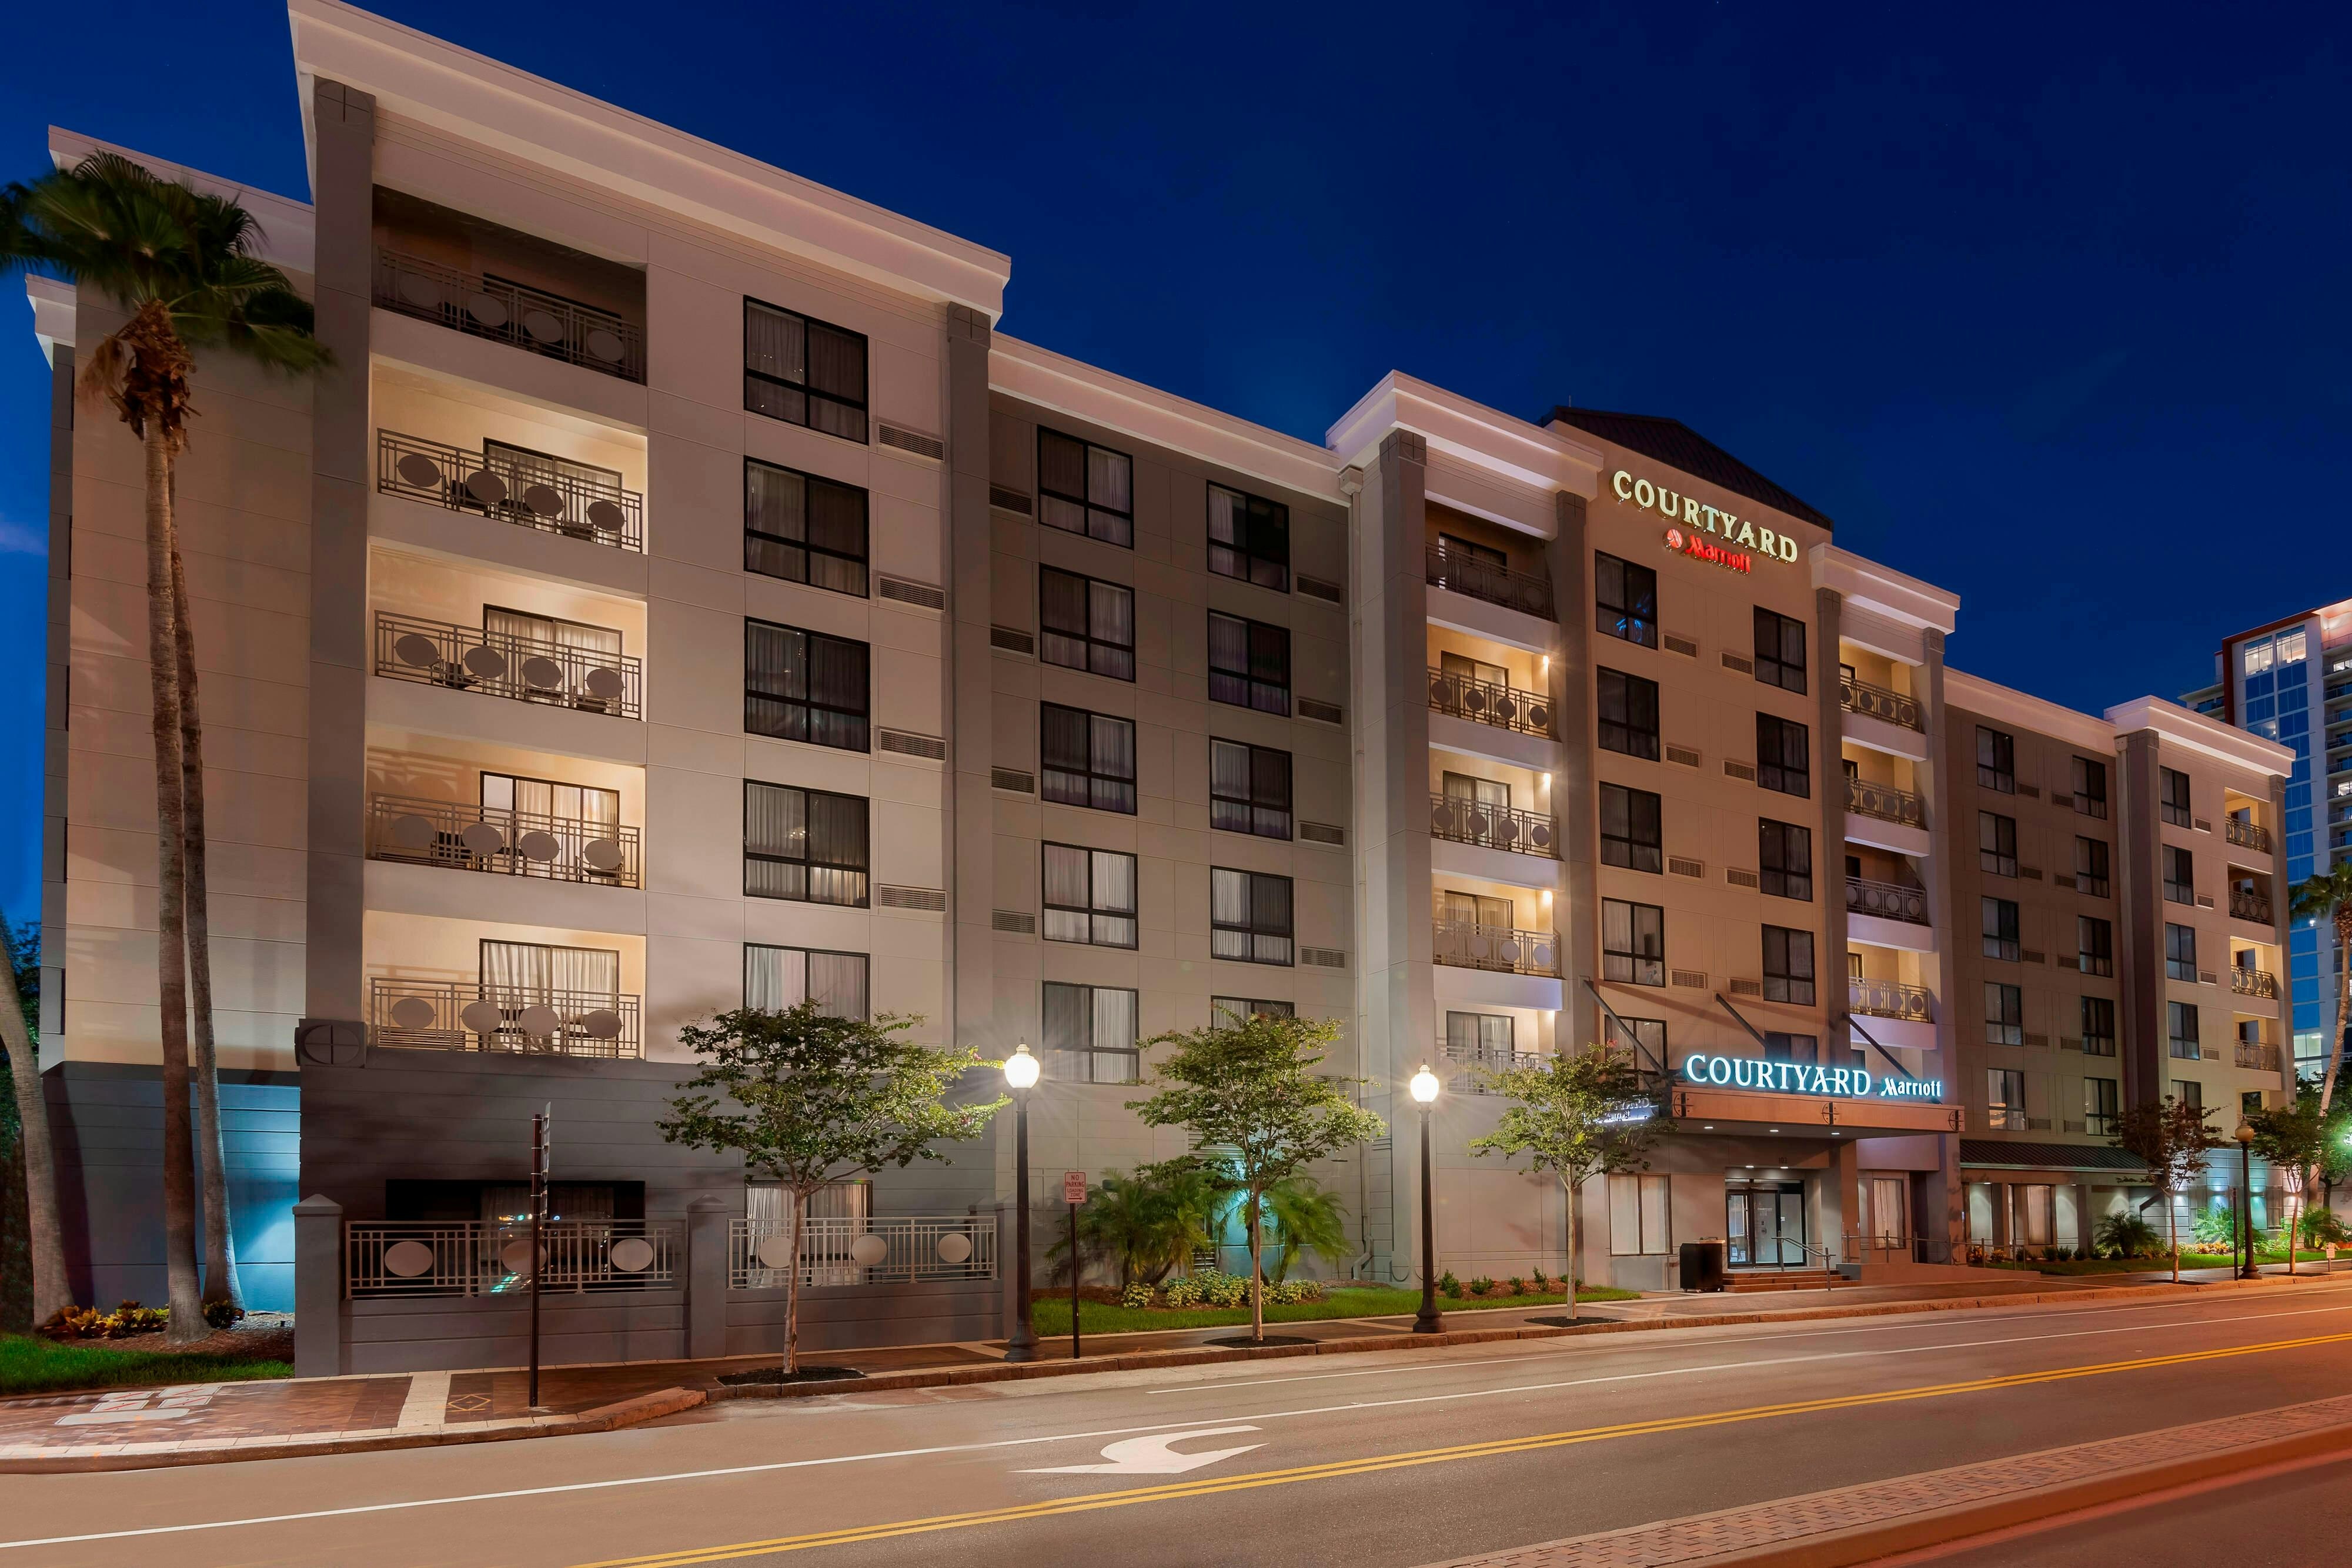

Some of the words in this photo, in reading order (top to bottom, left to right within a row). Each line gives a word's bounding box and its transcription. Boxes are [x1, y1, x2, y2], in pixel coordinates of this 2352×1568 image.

[1613, 470, 1798, 563] COURTYARD
[1685, 534, 1751, 573] Marriott
[1686, 1054, 1871, 1096] COURTYARD
[1880, 1077, 1942, 1097] Marriott
